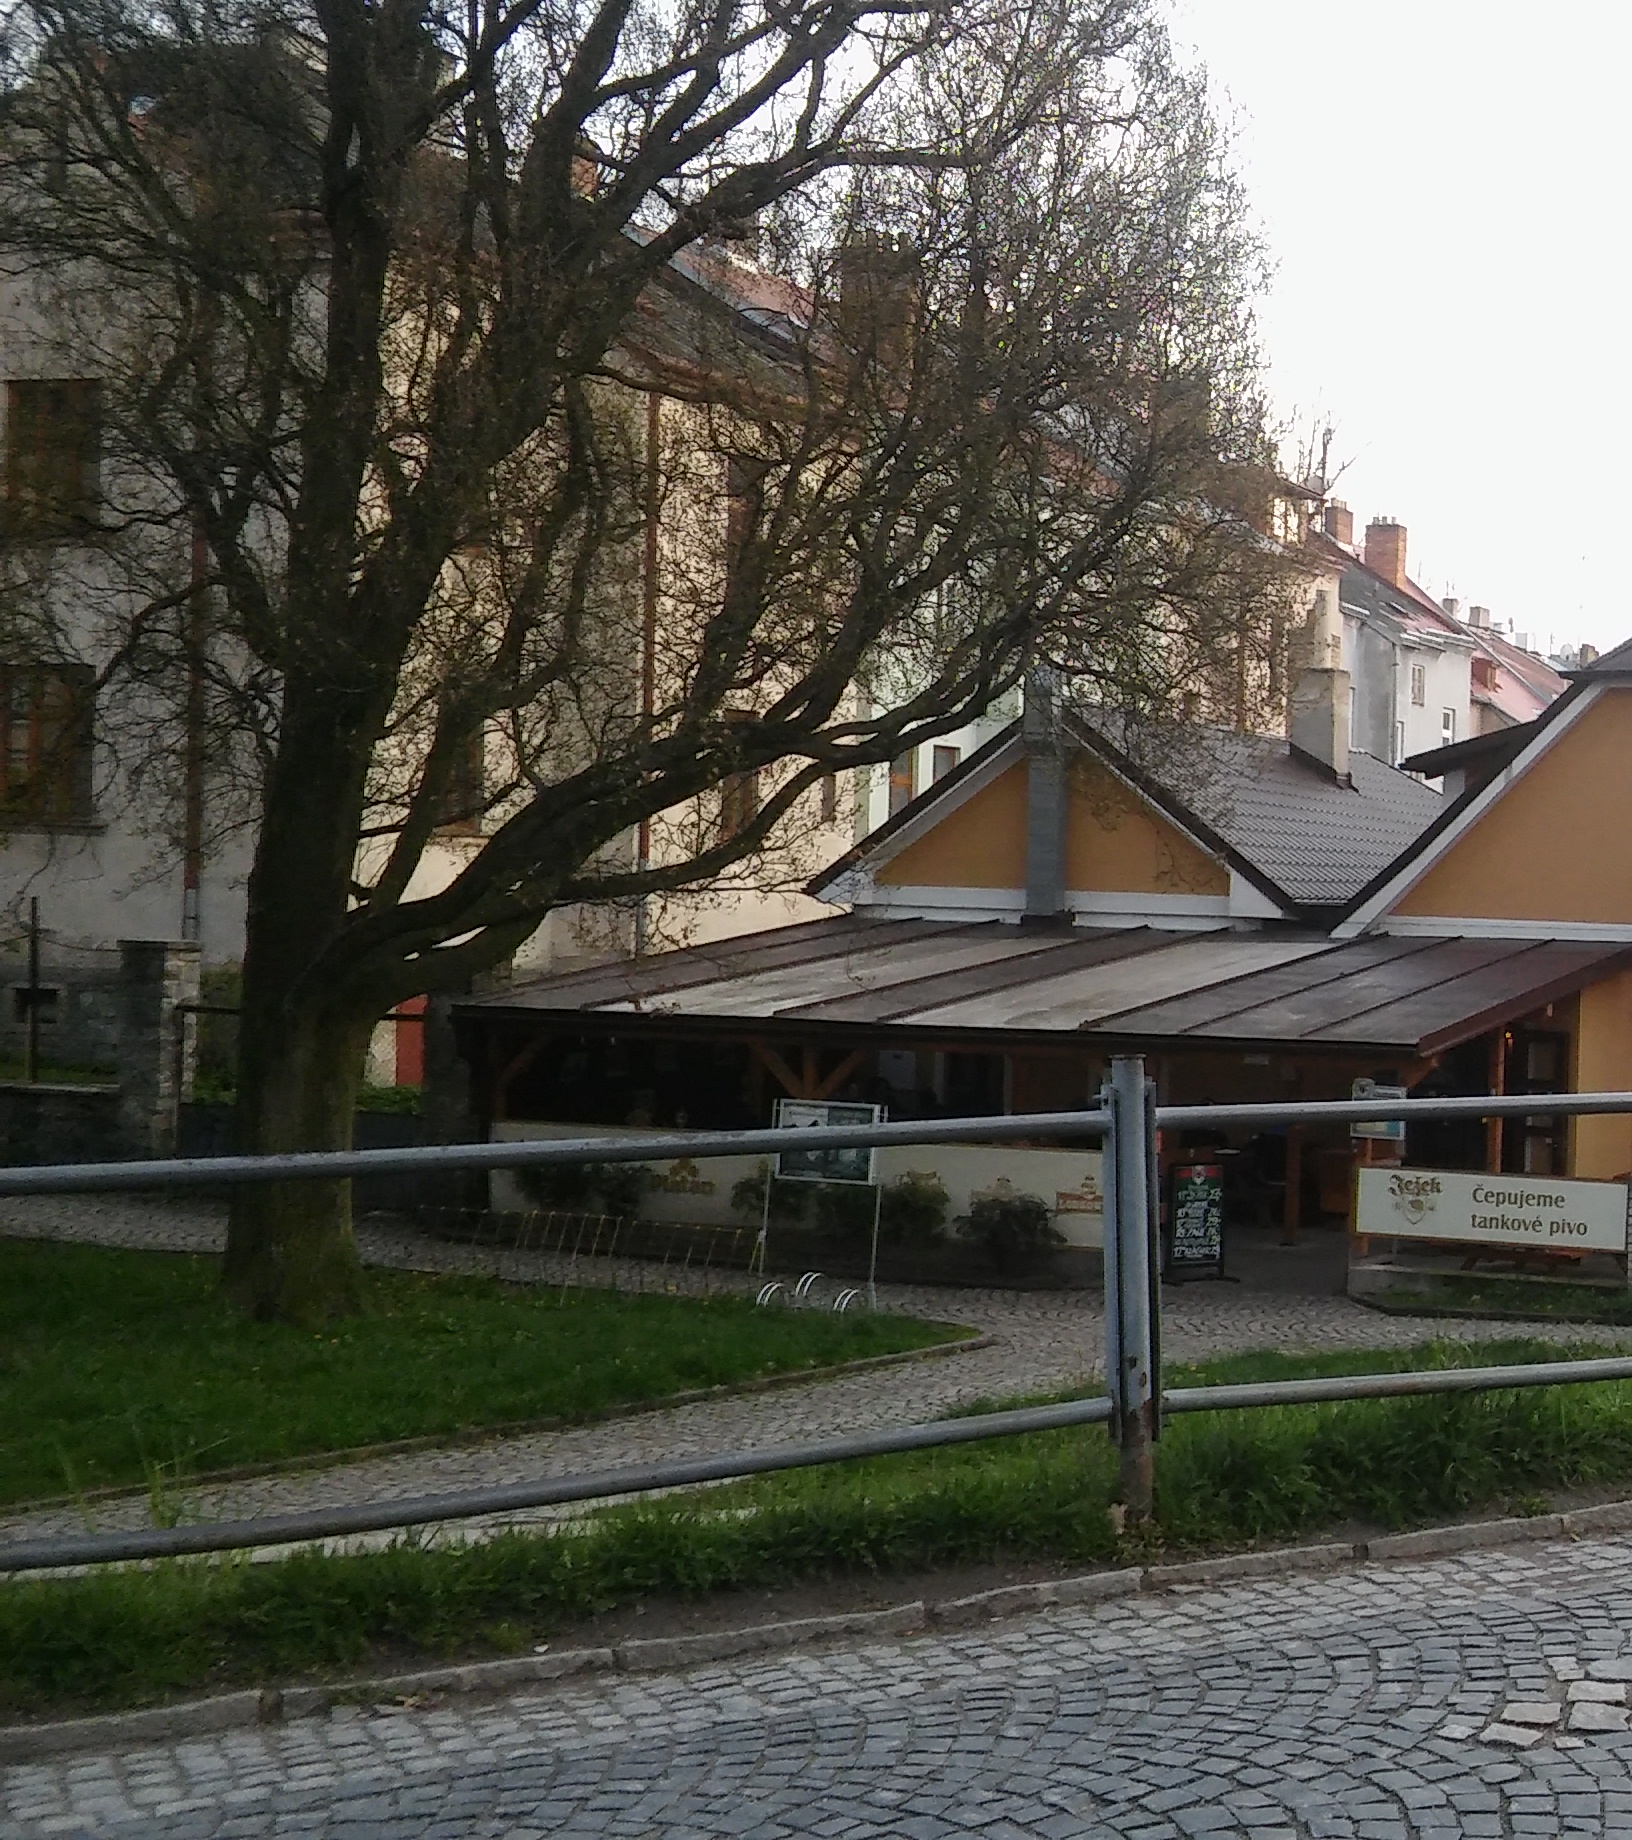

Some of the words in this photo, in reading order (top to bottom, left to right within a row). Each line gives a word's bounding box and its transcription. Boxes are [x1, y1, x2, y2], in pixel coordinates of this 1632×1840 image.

[1471, 1183, 1566, 1209] Čepujeme
[1470, 1213, 1543, 1233] tankové
[1549, 1218, 1588, 1237] pivo
